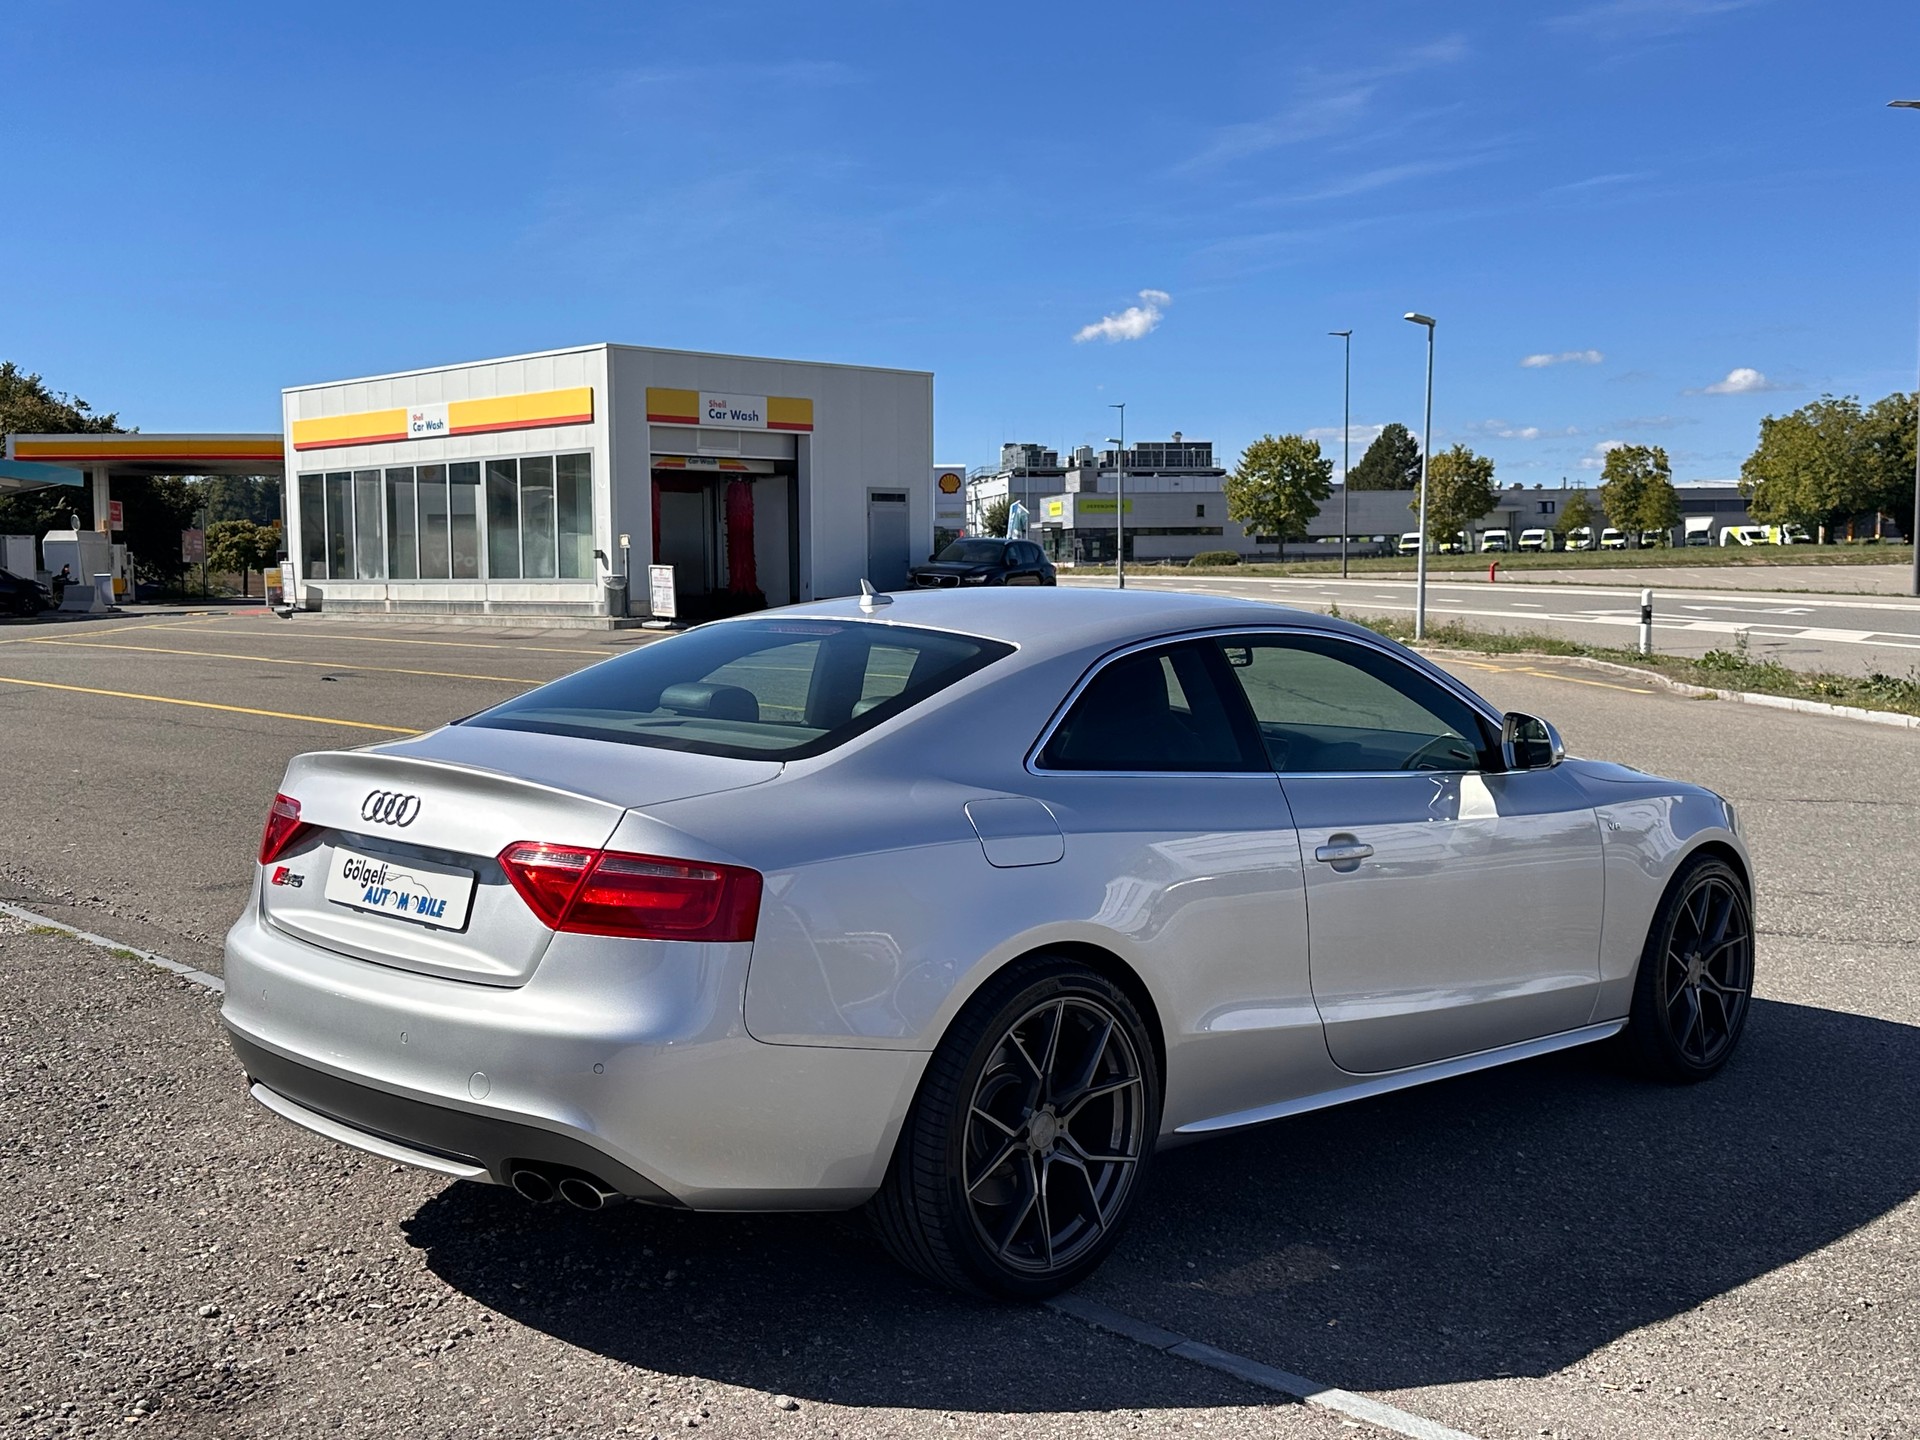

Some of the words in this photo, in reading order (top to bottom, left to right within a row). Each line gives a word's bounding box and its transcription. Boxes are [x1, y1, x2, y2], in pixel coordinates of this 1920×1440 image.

[708, 399, 727, 408] Shell
[708, 408, 727, 420] Car
[730, 409, 759, 422] Wash
[412, 421, 425, 432] Car
[425, 417, 444, 431] Wash
[700, 457, 717, 466] Wash
[343, 858, 388, 888] Gölgeli
[362, 885, 447, 918] AUTOMOBILE
